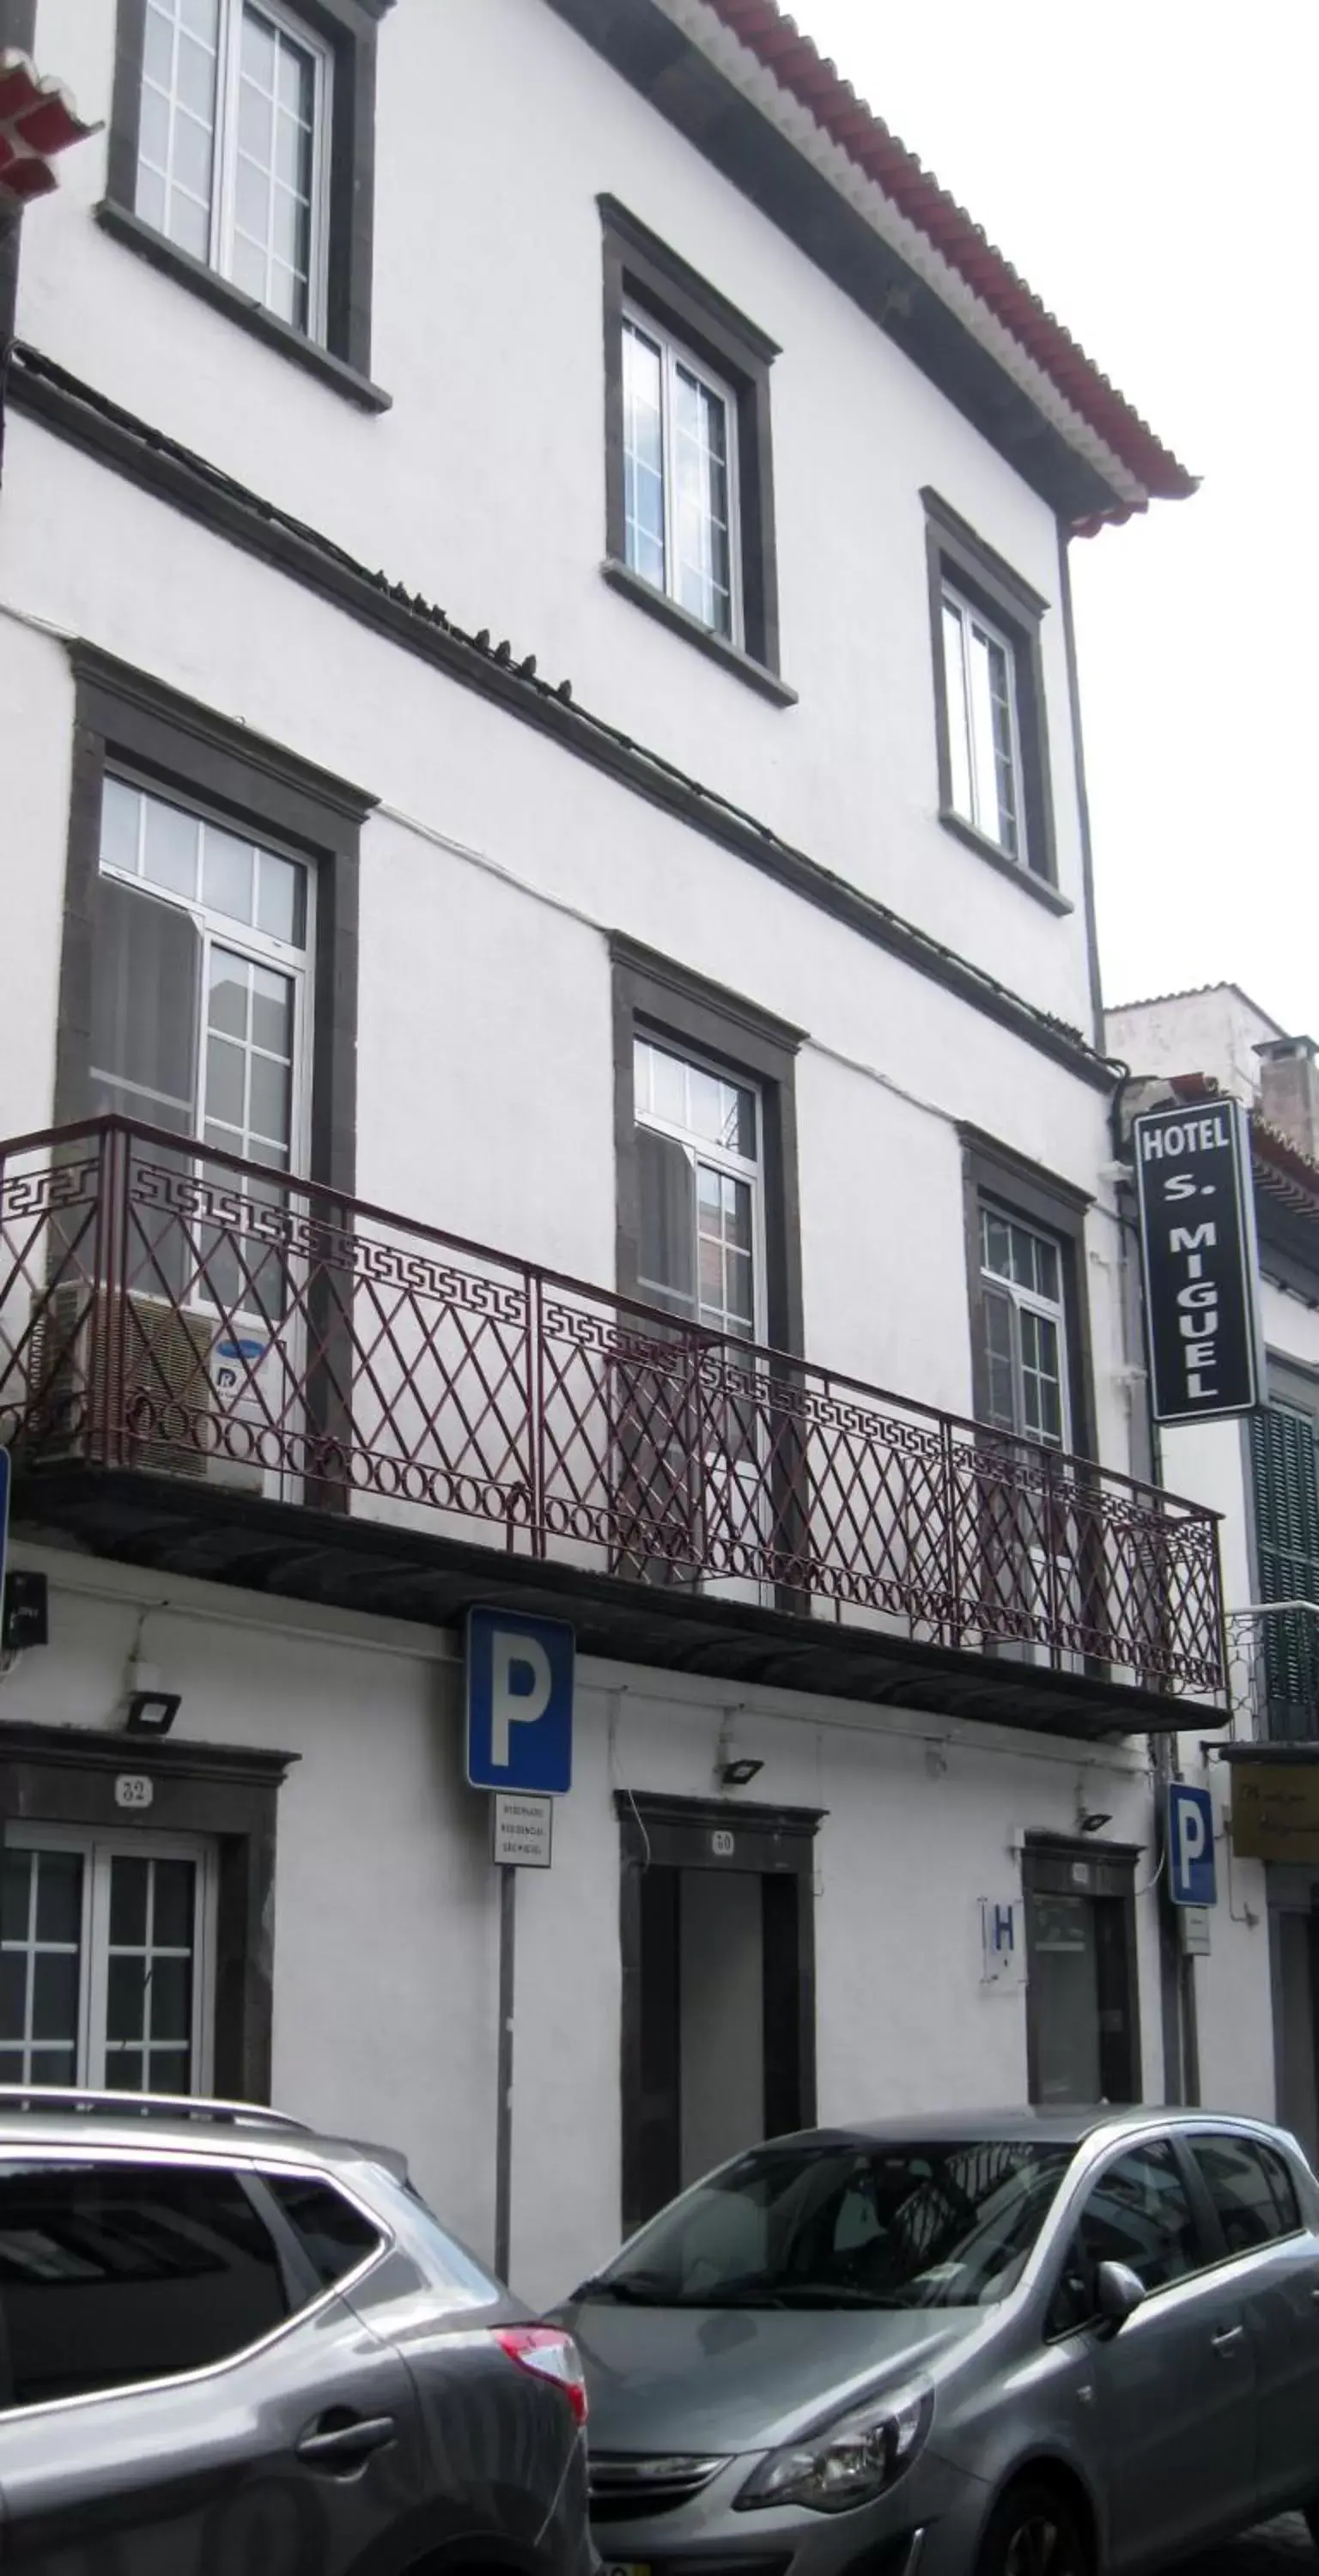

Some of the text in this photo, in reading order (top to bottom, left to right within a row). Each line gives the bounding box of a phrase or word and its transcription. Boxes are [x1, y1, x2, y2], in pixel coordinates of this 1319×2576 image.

[1143, 1118, 1229, 1161] HOTEL
[1164, 1174, 1216, 1200] S.
[1170, 1222, 1219, 1398] MIGUEL
[491, 1631, 552, 1766] P
[1177, 1797, 1205, 1889] P
[994, 1904, 1014, 1951] H
